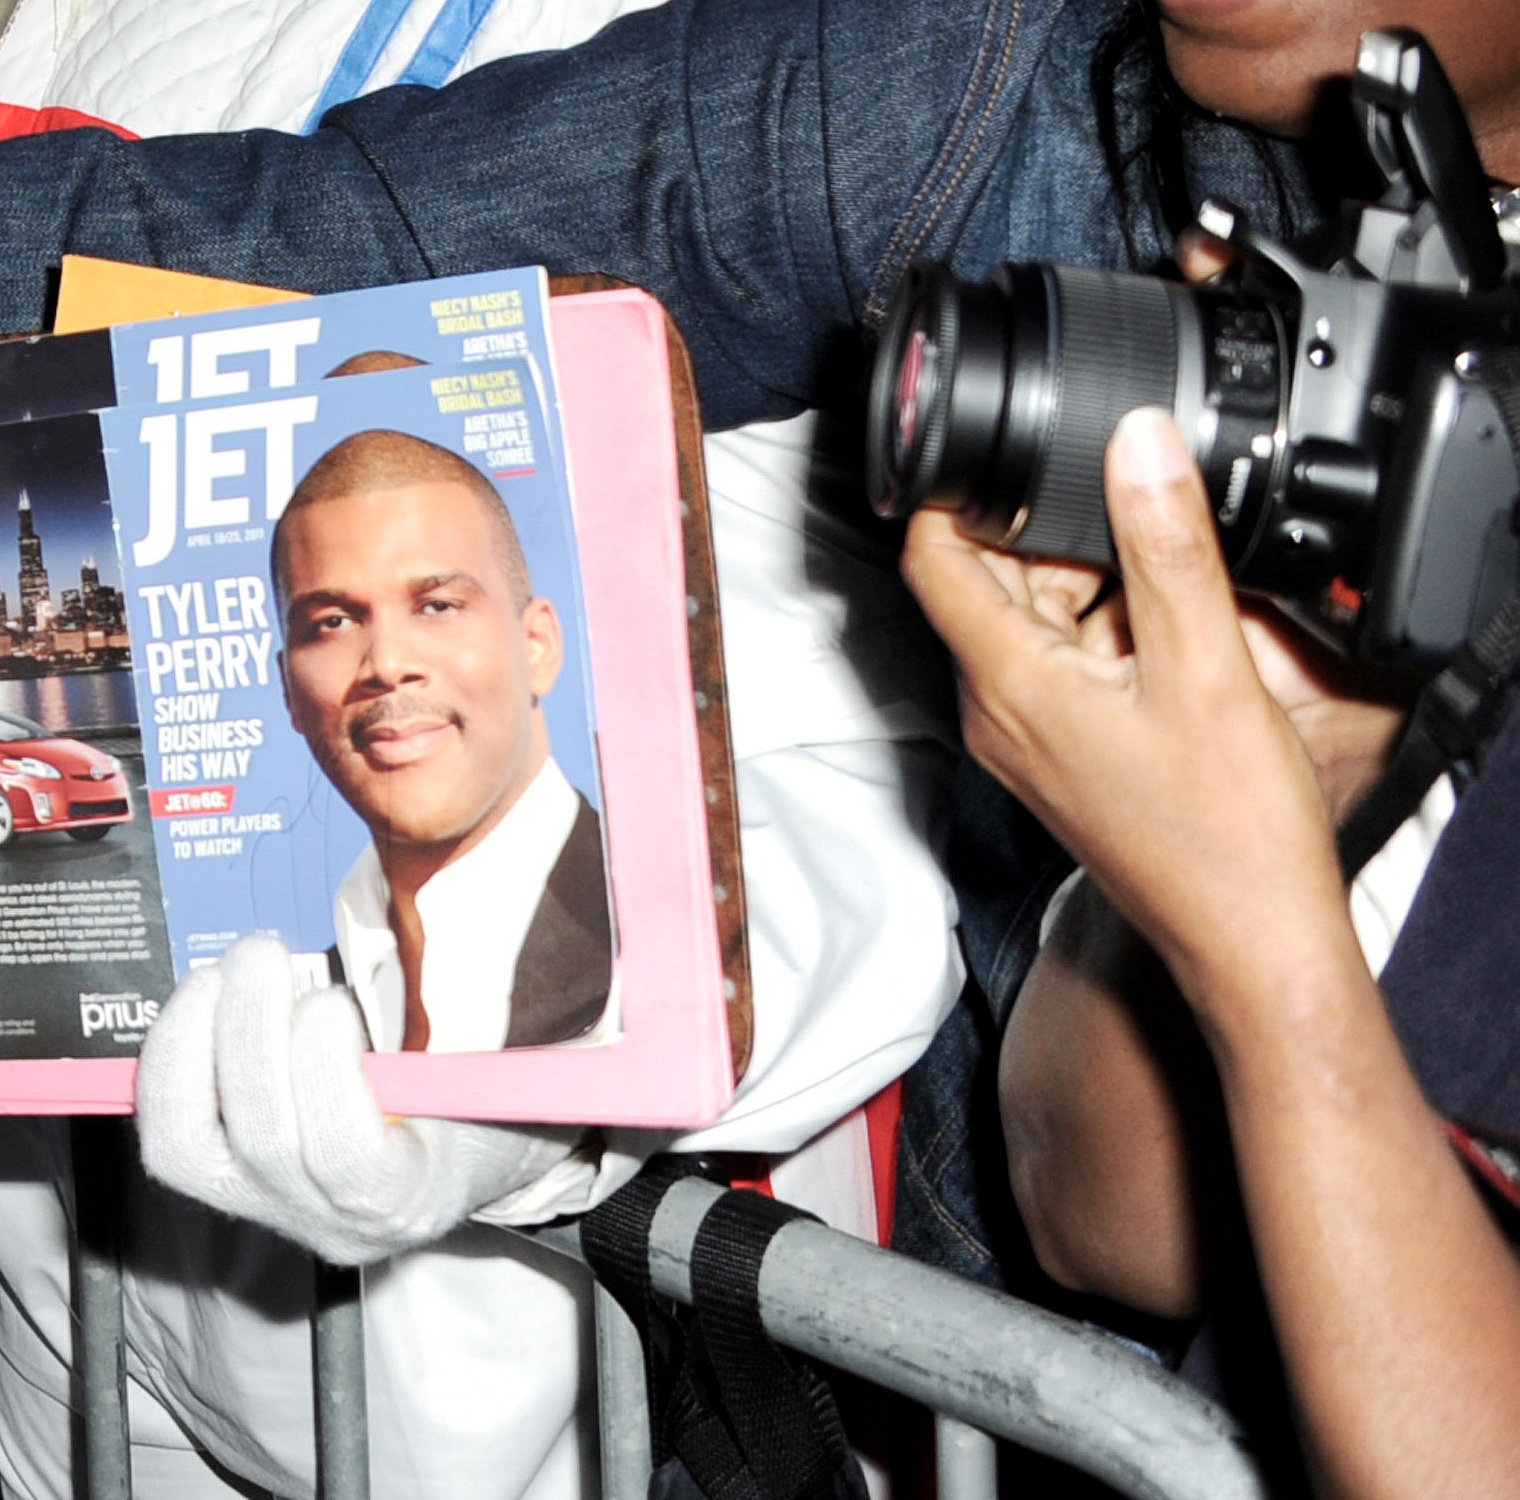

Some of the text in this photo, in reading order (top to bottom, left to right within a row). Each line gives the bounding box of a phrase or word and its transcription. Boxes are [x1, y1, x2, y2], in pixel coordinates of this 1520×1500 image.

[437, 308, 525, 336] BRIDAL BASH
[462, 330, 527, 355] ARETHA'S
[437, 387, 524, 414] BRIDAL BASH
[464, 410, 528, 434] ARETHA'S
[463, 428, 531, 453] BIG APPLE
[132, 396, 319, 567] JET
[138, 576, 269, 638] TYLER
[146, 631, 272, 695] PERRY
[154, 693, 220, 724] SHOW
[158, 719, 264, 754] BUSINESS
[161, 749, 251, 783] HIS WAY
[169, 813, 281, 838] POWER PLAYERS
[173, 838, 243, 859] TO WATCH
[80, 999, 159, 1038] prius
